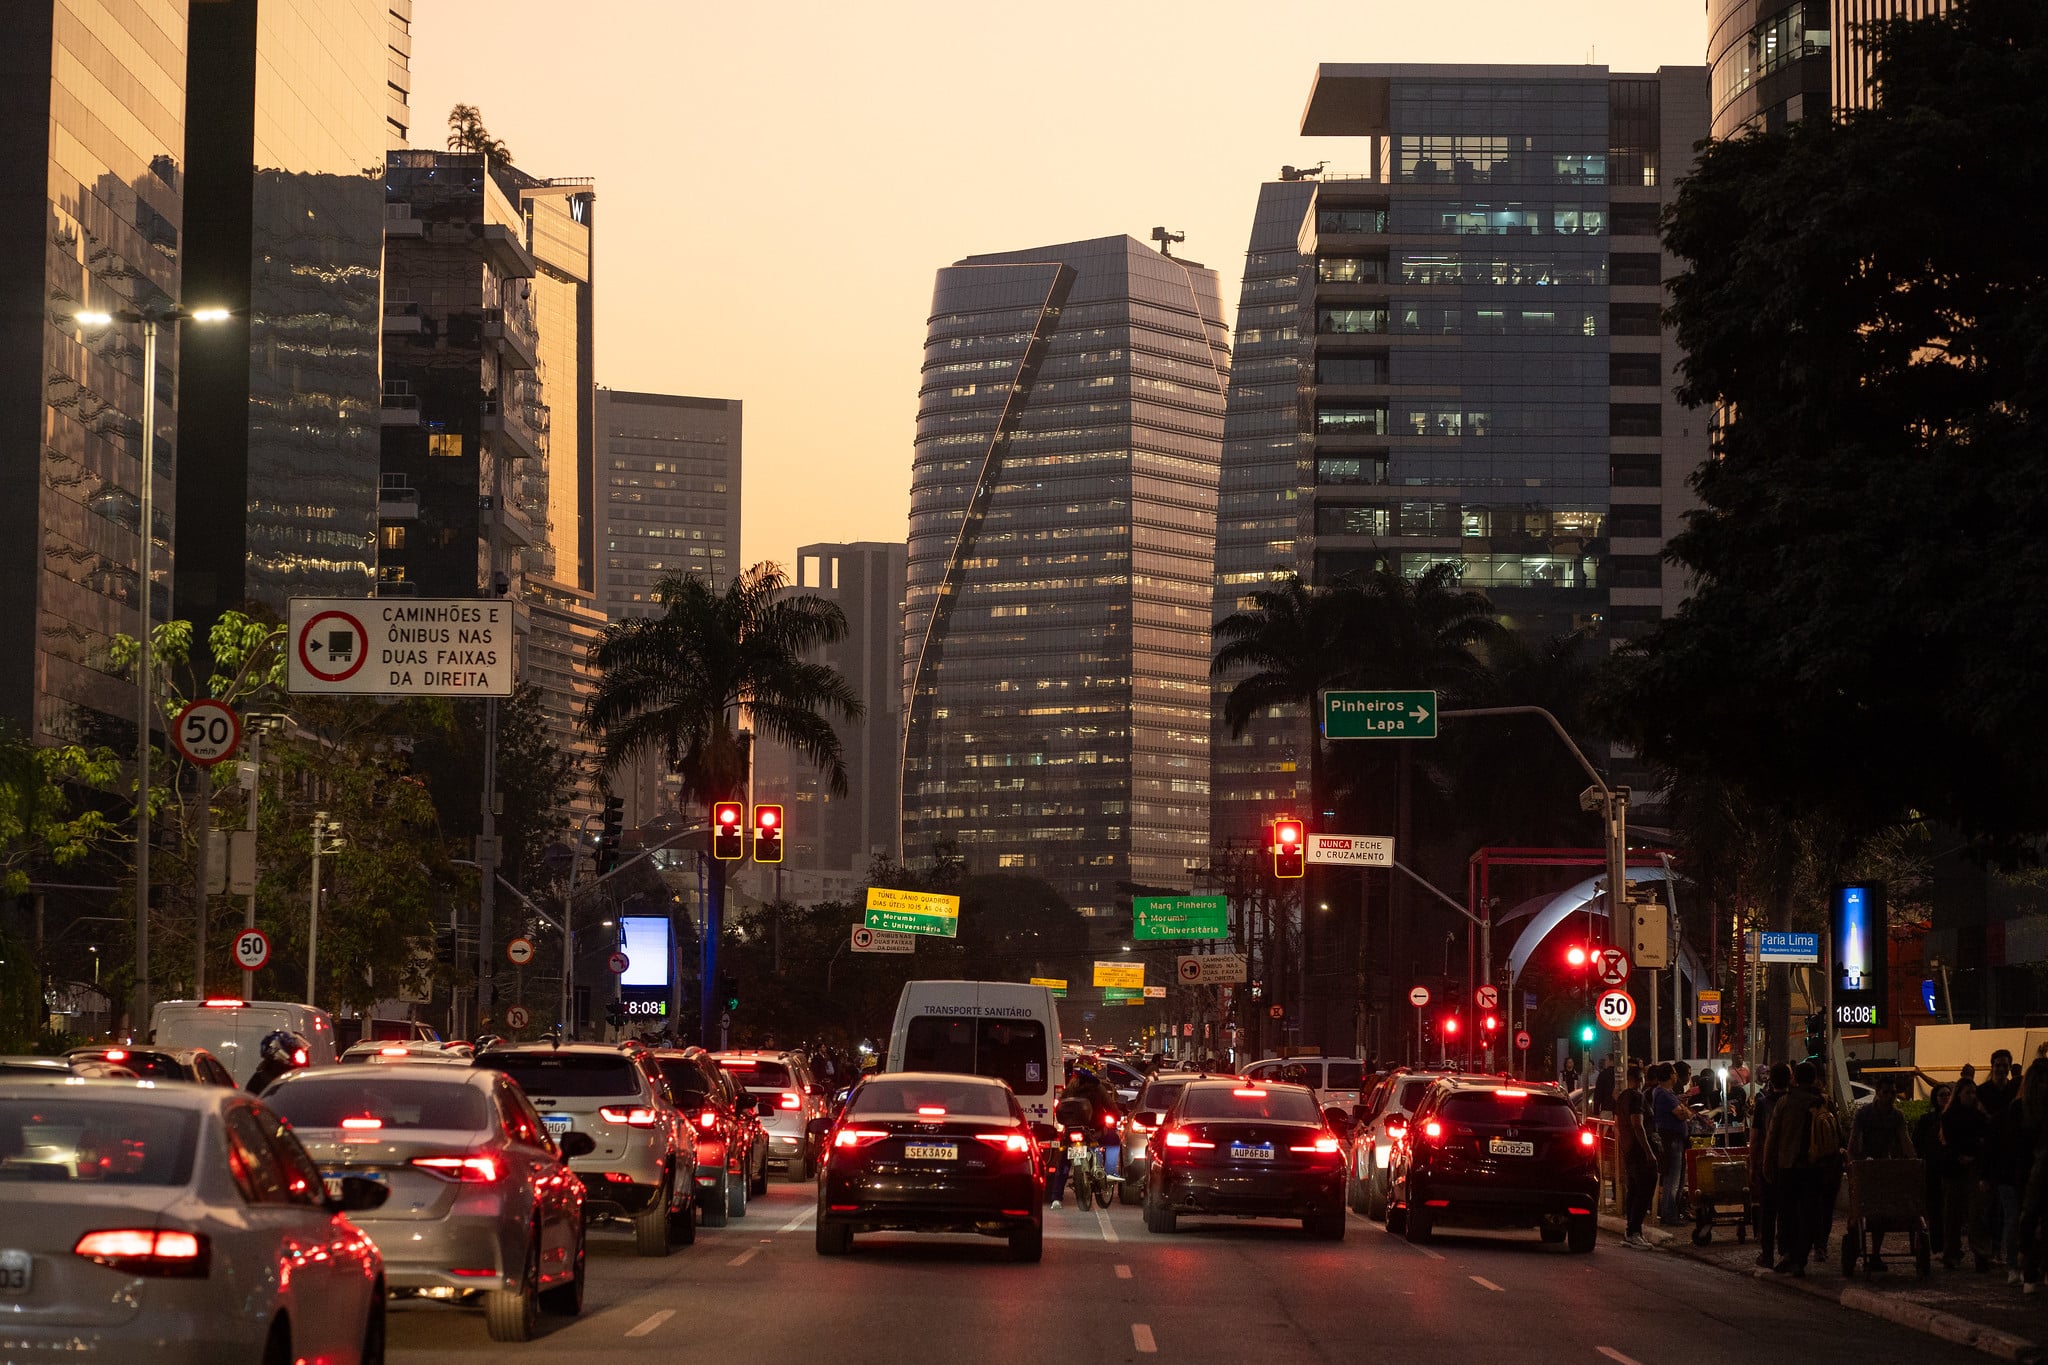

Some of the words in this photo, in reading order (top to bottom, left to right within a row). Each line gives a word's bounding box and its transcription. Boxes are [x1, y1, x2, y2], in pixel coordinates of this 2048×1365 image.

[571, 196, 584, 224] W
[382, 604, 480, 622] CAMINHÕES
[490, 608, 498, 622] E
[388, 624, 450, 643] ÔNIBUS
[458, 629, 492, 644] NAS
[382, 650, 428, 664] DUAS
[438, 651, 497, 665] FAIXAS
[390, 672, 412, 686] DA
[424, 672, 488, 687] DIREITA
[1331, 700, 1404, 712] Pinheiros
[186, 716, 228, 744] 50
[1366, 718, 1404, 732] Lapa
[1320, 841, 1350, 849] NUNCA
[1354, 842, 1382, 850] FECHE
[1327, 851, 1384, 860] CRUZAMENTO
[878, 891, 897, 899] TÚNEL
[921, 896, 950, 904] QUADROS
[883, 914, 916, 922] Morumbi
[892, 922, 941, 932] Universitária
[1162, 926, 1219, 934] Universitária
[240, 938, 263, 955] 50
[1761, 934, 1786, 945] Faria
[1789, 935, 1814, 946] Lima
[924, 1005, 982, 1015] TRANSPORTE
[984, 1006, 1032, 1017] SANITÁRIO
[1604, 998, 1628, 1015] 50
[1836, 1006, 1870, 1022] 18:08
[910, 1148, 952, 1158] SEK3A96
